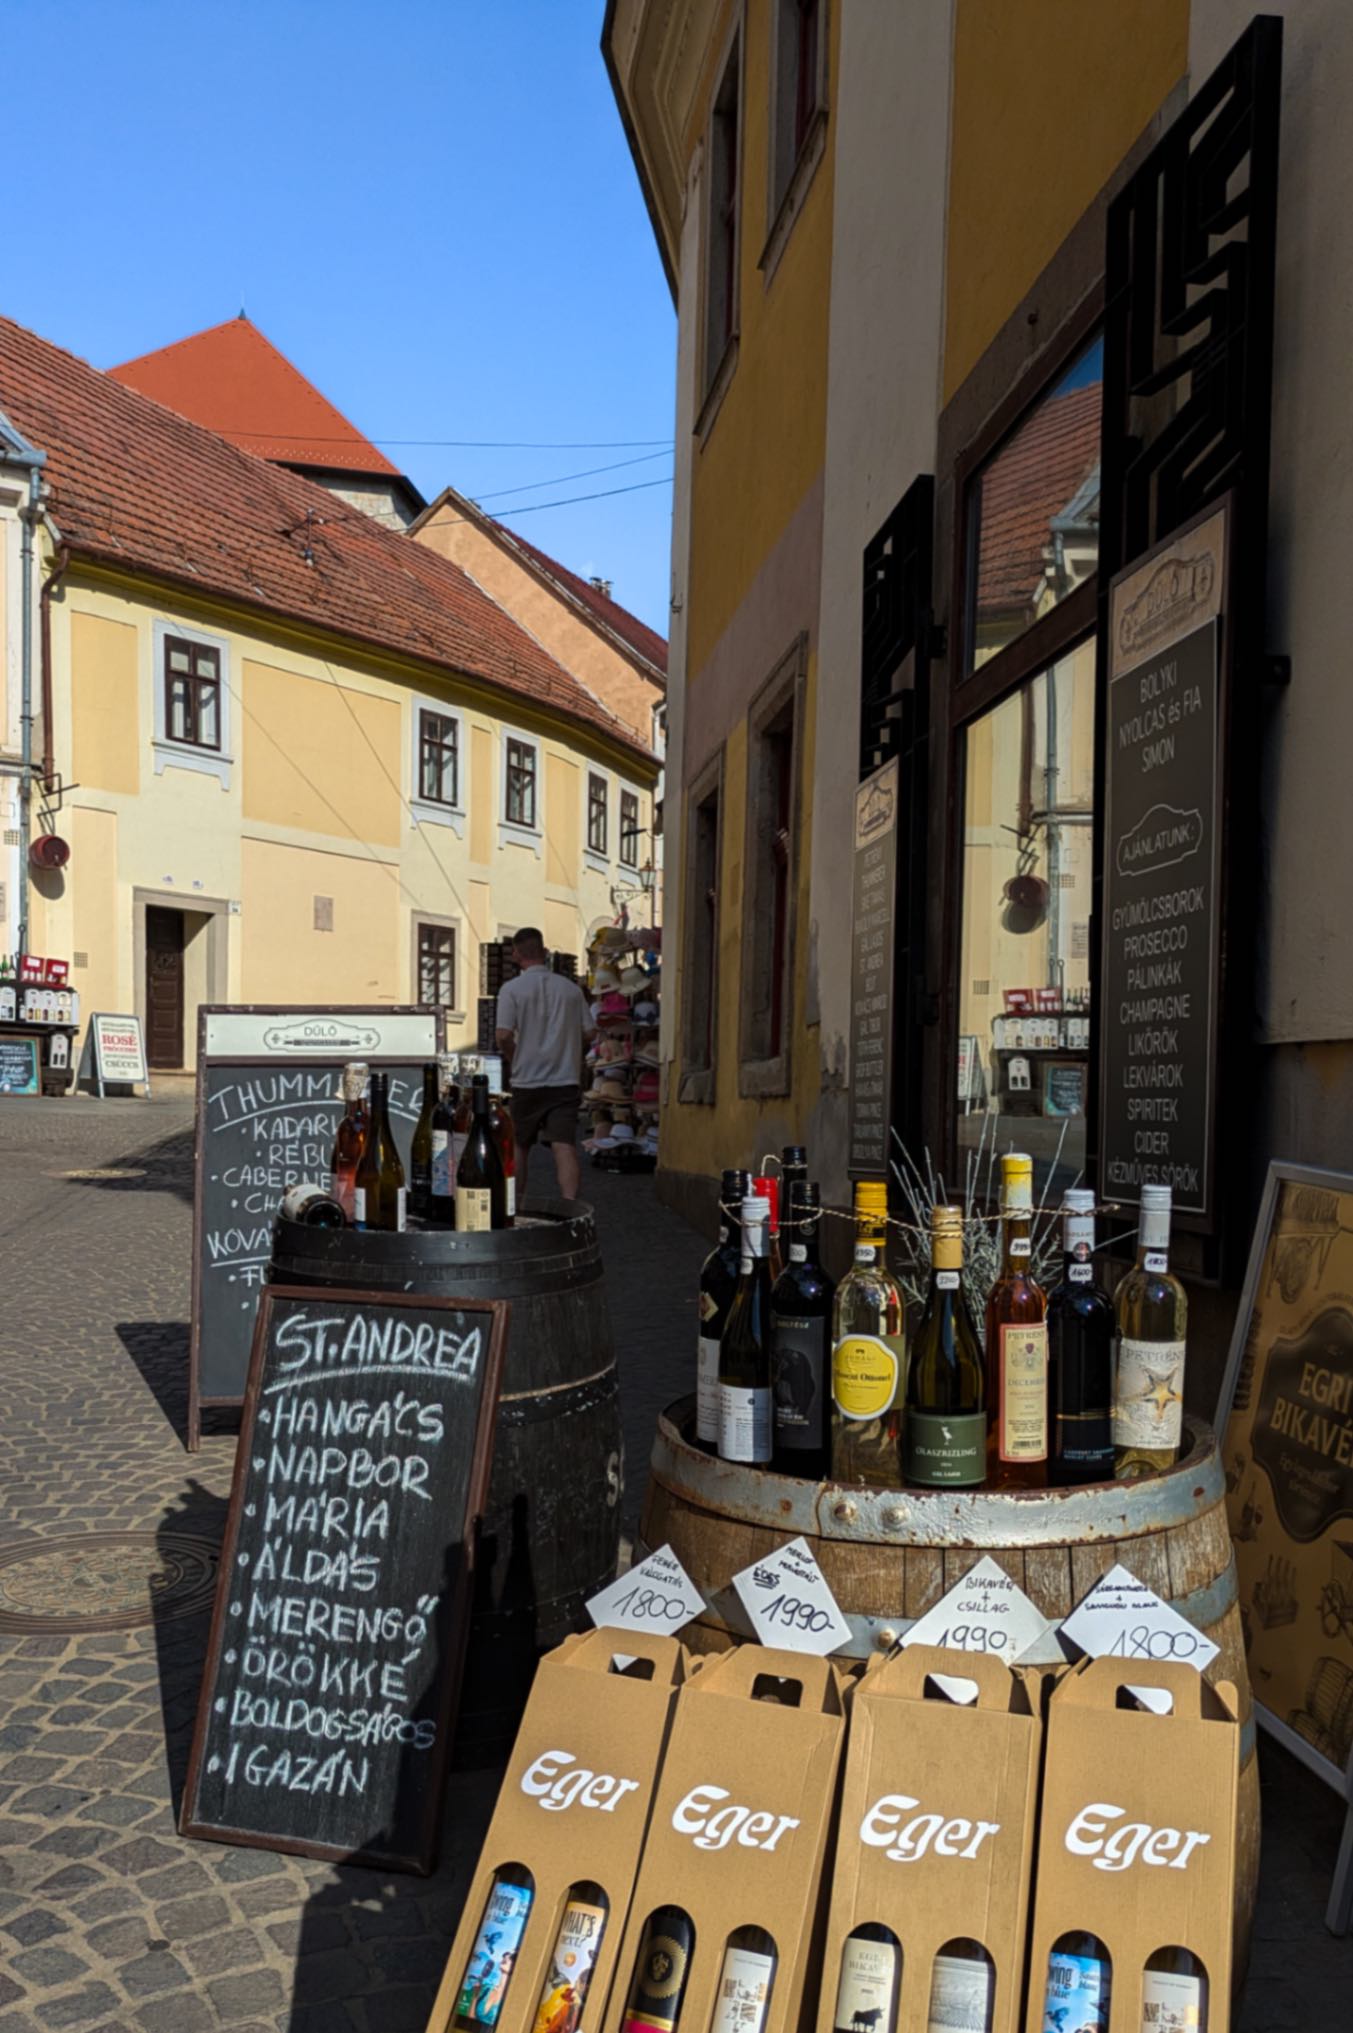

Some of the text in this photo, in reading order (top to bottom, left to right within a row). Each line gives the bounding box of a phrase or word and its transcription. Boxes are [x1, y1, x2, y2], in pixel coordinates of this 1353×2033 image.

[1140, 661, 1178, 703] BOLYKI
[1118, 685, 1202, 750] NYOLCAS és FIA
[1141, 736, 1176, 773] SIMON
[1123, 925, 1188, 961] PROSECCO
[1126, 959, 1182, 992] PÁLINKÁK
[1119, 994, 1191, 1026] CHAMPAGNE
[1123, 1060, 1184, 1089] LEKVÁROK
[1127, 1098, 1179, 1122] SPIRITEK
[1134, 1131, 1170, 1156] CIDER
[223, 1165, 331, 1192] CABERNE
[1298, 1361, 1353, 1415] EGRI
[1270, 1396, 1353, 1470] BIKAVÉ
[267, 1443, 433, 1500] NAPBOR
[264, 1489, 389, 1539] MÁRIA
[252, 1537, 381, 1592] ÁLDÁS
[957, 1601, 1010, 1613] CSILLAG
[243, 1635, 422, 1702] ÖRÖKKÉ
[521, 1750, 640, 1812] Eger
[672, 1785, 800, 1851] Eger
[860, 1794, 1001, 1862] Eger
[1065, 1803, 1212, 1871] Eger
